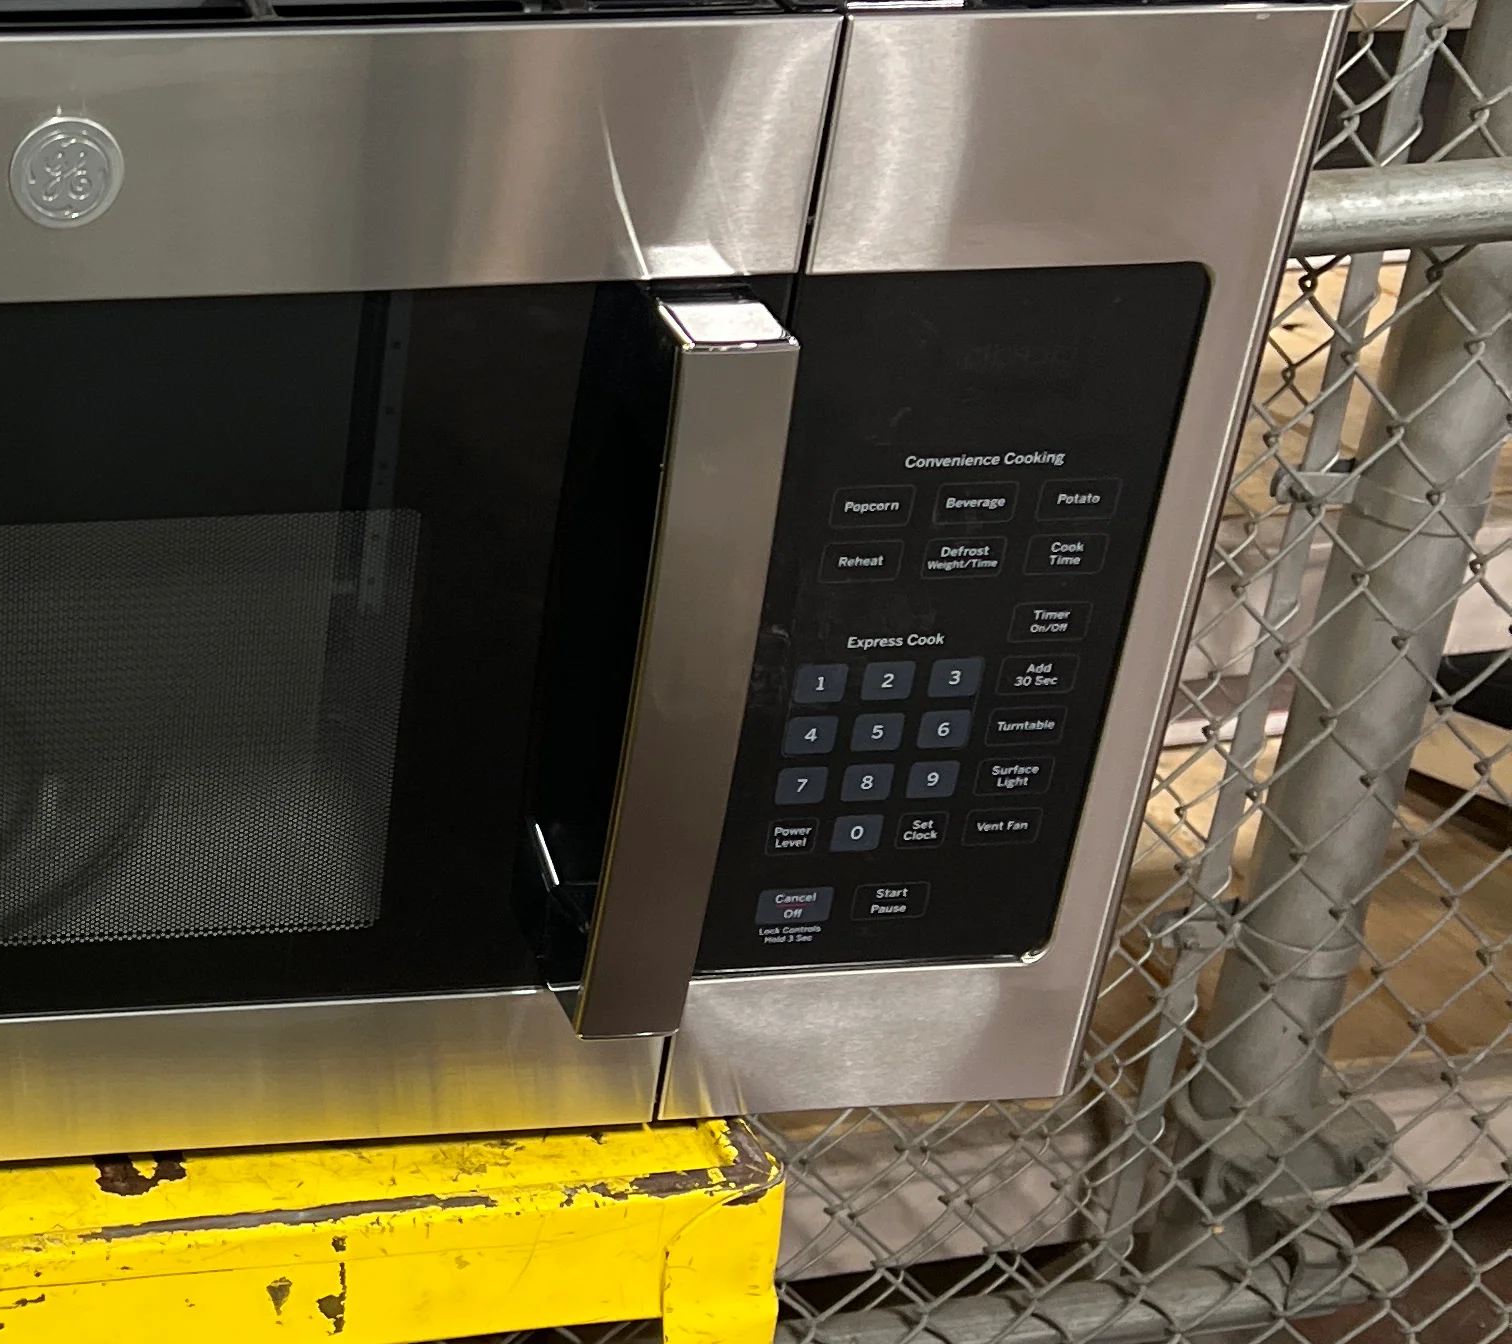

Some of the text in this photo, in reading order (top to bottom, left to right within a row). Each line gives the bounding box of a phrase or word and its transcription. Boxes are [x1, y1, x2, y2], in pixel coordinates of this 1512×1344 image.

[904, 451, 1066, 469] Convenience Cooking
[945, 497, 1006, 510] Beverage
[1056, 492, 1101, 505] Potato
[843, 501, 900, 514] Popcorn
[940, 545, 990, 558] Defrost
[1050, 541, 1085, 553] Cook
[838, 555, 884, 568] Reheat
[927, 558, 999, 572] Weight/Time
[1049, 554, 1082, 566] Time
[1033, 609, 1071, 621] Timer
[1029, 622, 1069, 633] On/Off
[846, 632, 945, 651] Express Cook
[1025, 663, 1053, 674] Add
[815, 676, 825, 691] 1
[881, 673, 895, 688] 2
[948, 670, 962, 685] 3
[1013, 675, 1059, 687] 30 Sec
[870, 724, 884, 740] 5
[937, 721, 950, 737] 6
[997, 719, 1056, 732] Turntable
[803, 727, 818, 742] 4
[991, 764, 1040, 776] Surface
[796, 778, 809, 793] 7
[860, 775, 874, 790] 8
[926, 771, 940, 787] 9
[996, 776, 1029, 789] Light
[912, 819, 934, 830] Set
[976, 820, 1030, 832] Vent Fan
[774, 826, 812, 837] Power
[850, 825, 864, 840] 0
[903, 828, 938, 840] Clock
[774, 836, 807, 849] Level
[775, 892, 817, 904] Cancel
[875, 887, 909, 899] Start
[783, 908, 803, 919] Off
[870, 903, 907, 915] Pause
[781, 925, 822, 935] Controls
[795, 934, 813, 943] Sec
